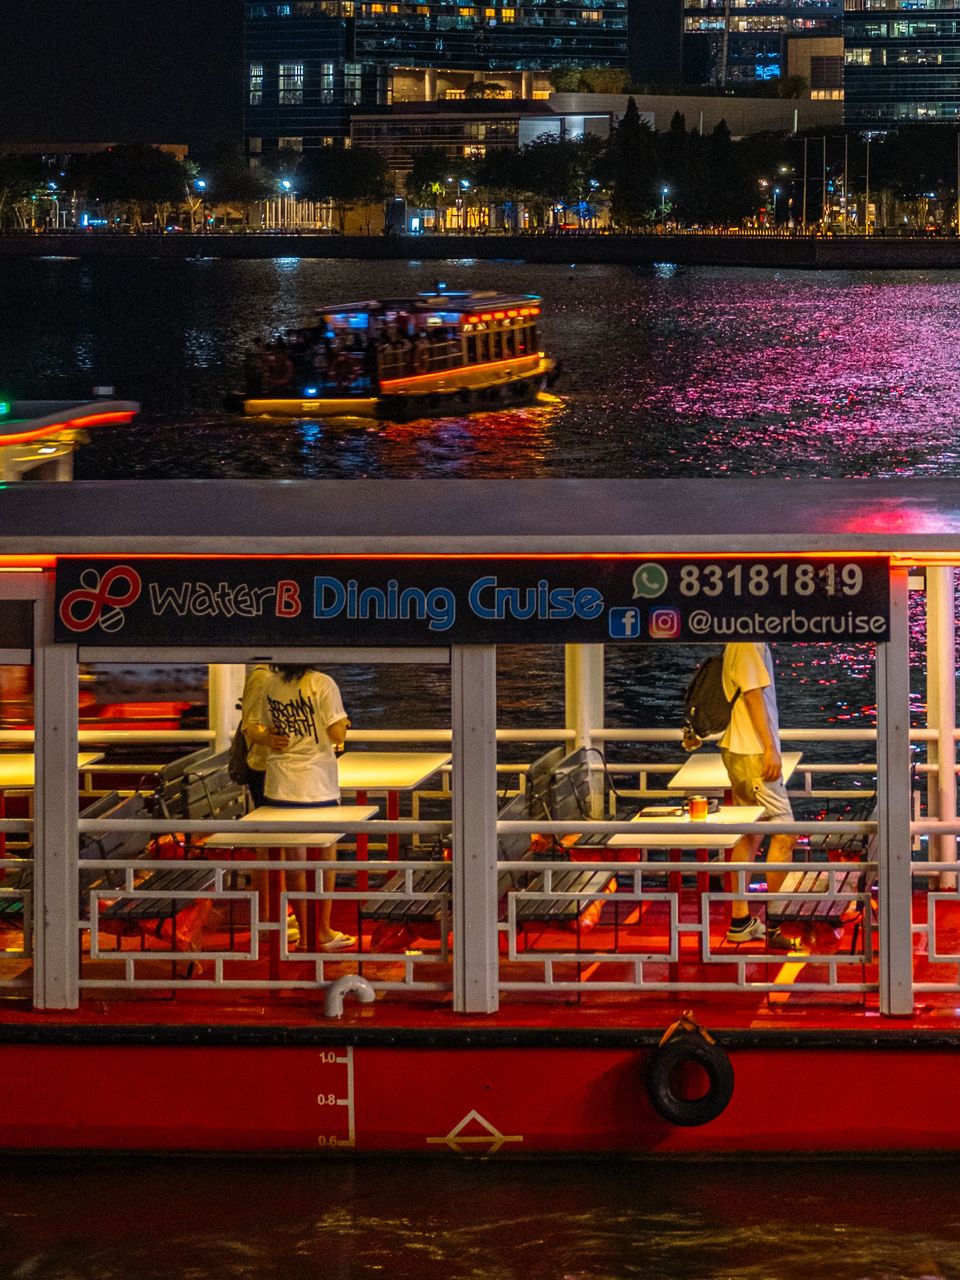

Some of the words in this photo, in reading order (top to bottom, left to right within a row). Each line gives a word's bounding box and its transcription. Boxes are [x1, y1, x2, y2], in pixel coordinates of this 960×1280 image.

[679, 563, 863, 597] 83181819
[313, 575, 456, 631] Dining
[468, 576, 605, 620] Cruise
[688, 610, 886, 635] @waterbcruise
[319, 1052, 336, 1063] 1.0
[317, 1094, 336, 1105] 0.8
[318, 1135, 337, 1147] 0.6
